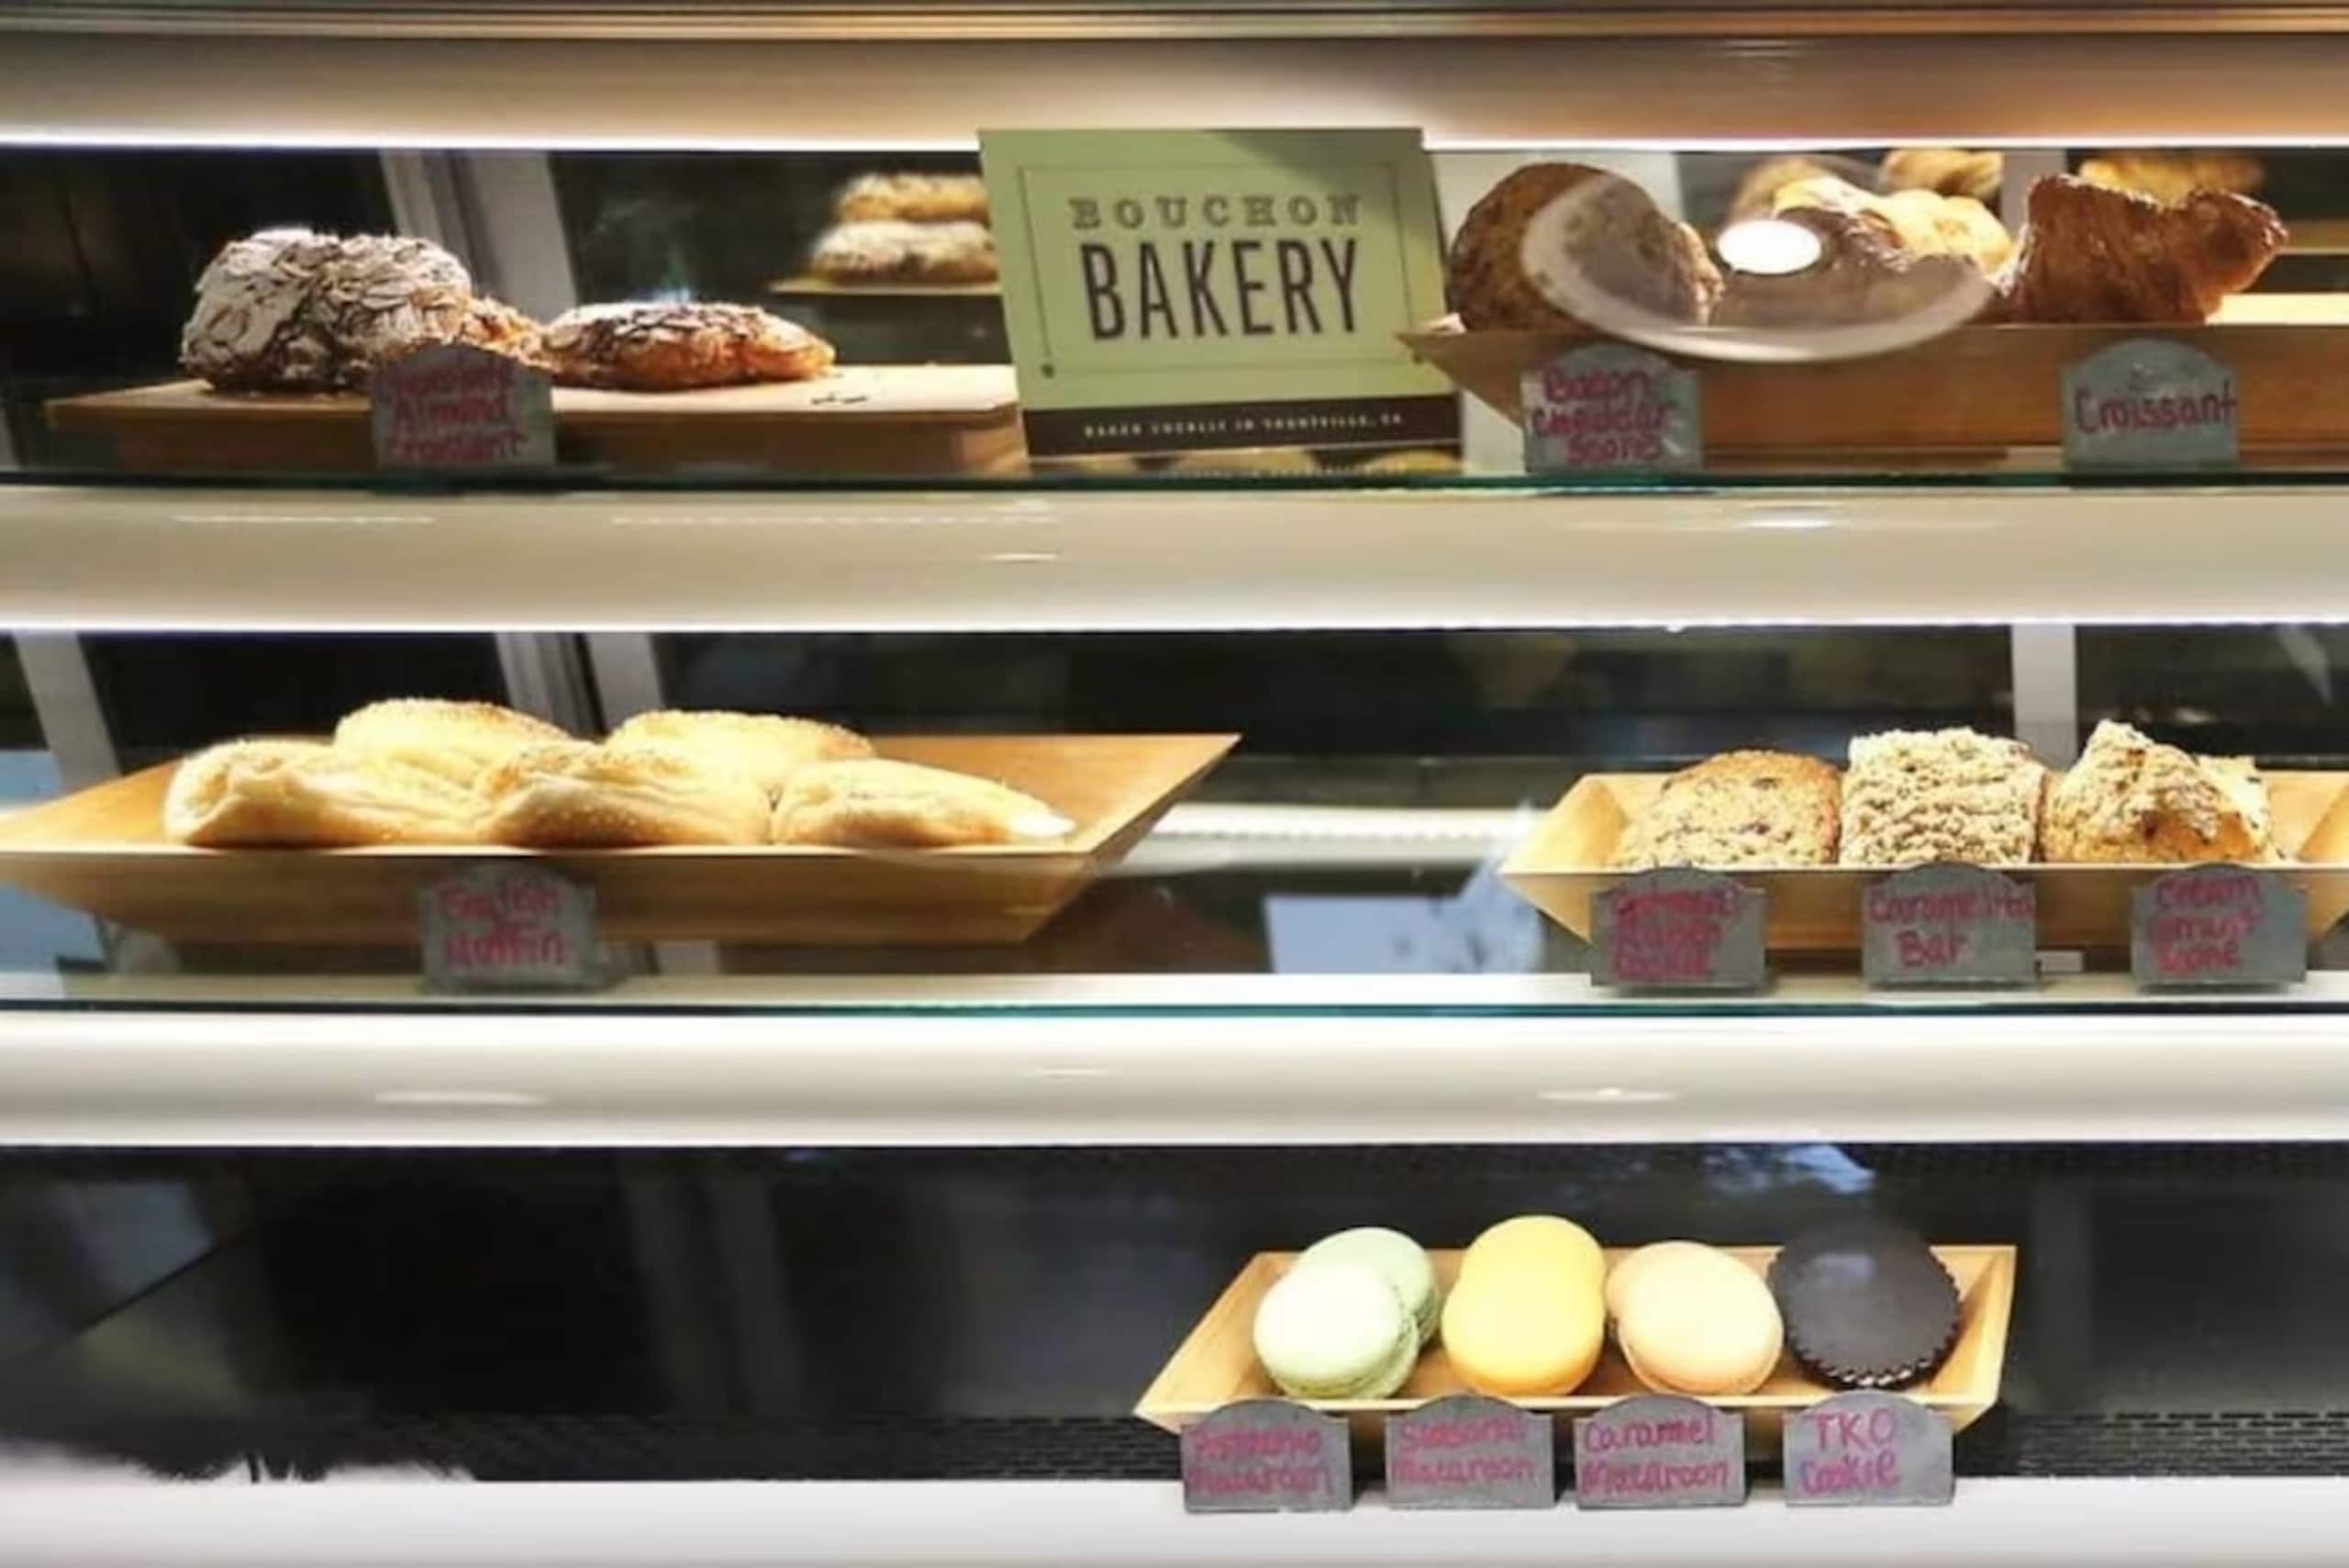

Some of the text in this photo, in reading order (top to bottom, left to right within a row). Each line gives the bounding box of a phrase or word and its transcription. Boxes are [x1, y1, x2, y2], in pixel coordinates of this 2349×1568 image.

[1069, 194, 1363, 230] BOUCHON
[1080, 237, 1357, 341] BAKERY
[2074, 378, 2239, 433] Croissant
[1896, 927, 1968, 969] Bar
[1585, 1408, 1718, 1452] Caramel
[1805, 1407, 1896, 1451] TKO
[1798, 1448, 1902, 1496] Cookie
